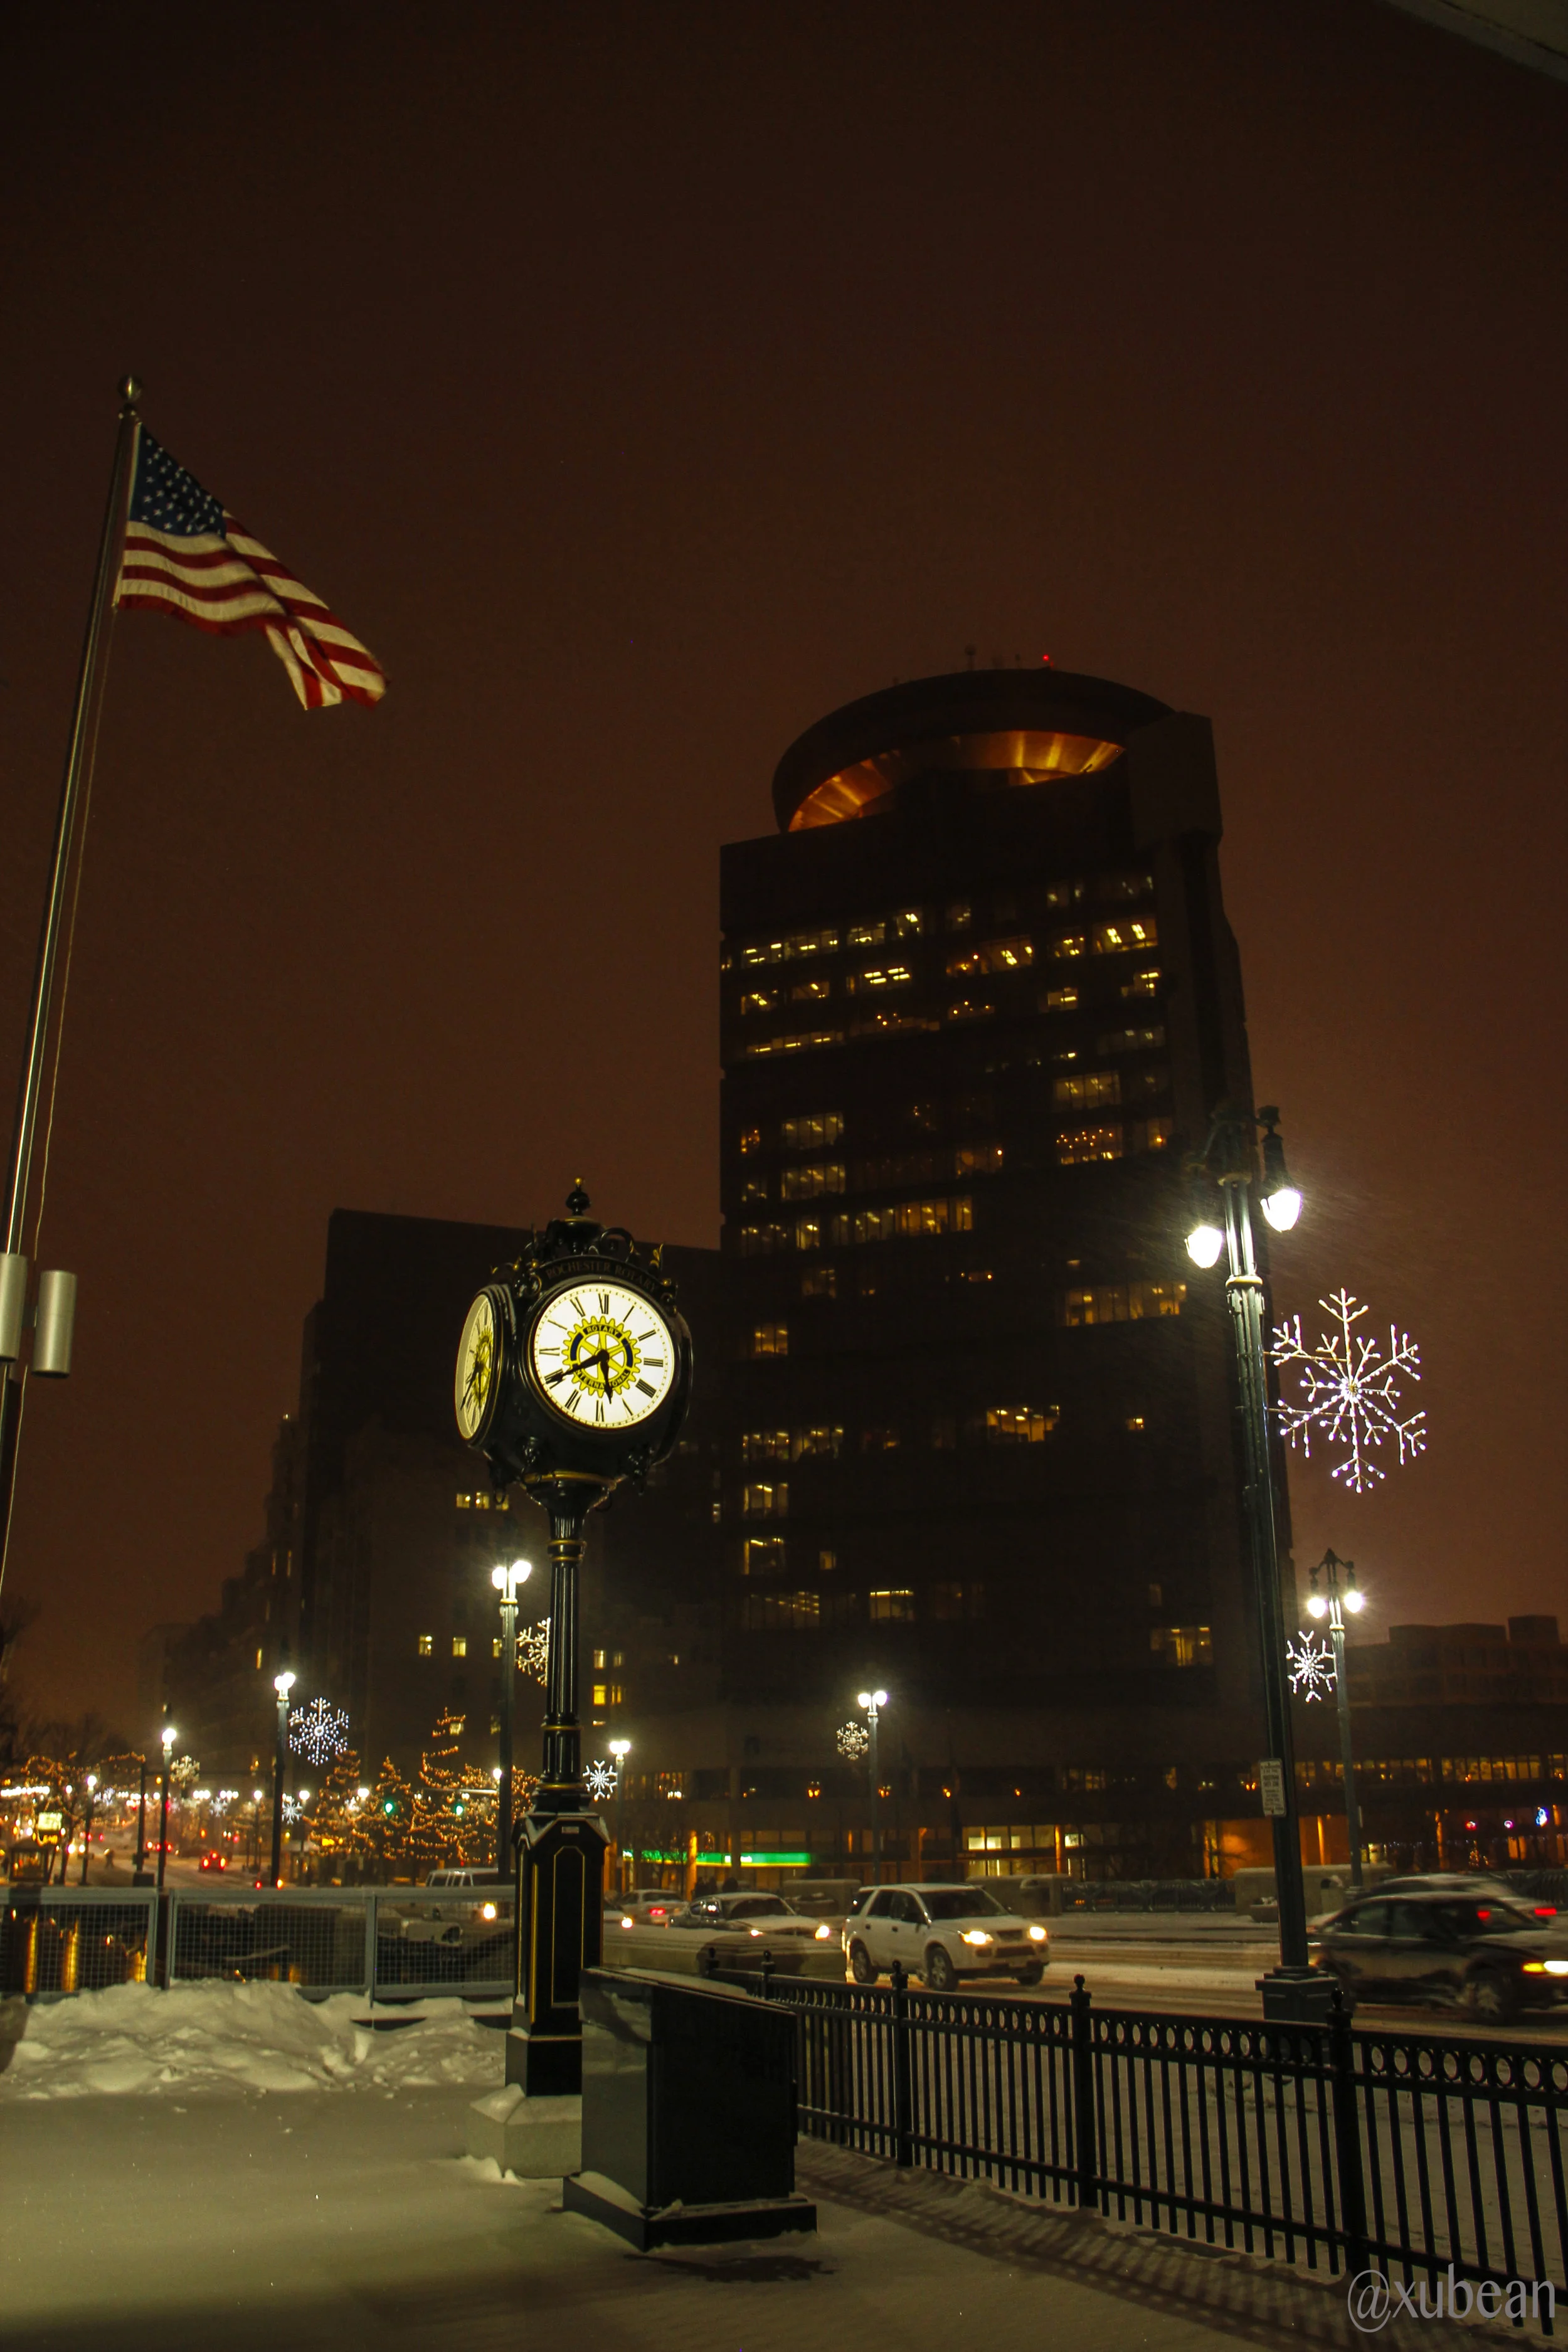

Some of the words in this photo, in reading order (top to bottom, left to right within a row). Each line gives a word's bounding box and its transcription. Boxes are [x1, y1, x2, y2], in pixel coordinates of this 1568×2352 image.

[546, 1261, 611, 1279] ROCHESTER
[615, 1264, 659, 1293] ROTARY
[586, 1325, 619, 1336] ROTARY
[575, 1369, 629, 1389] NTERNAIONAL
